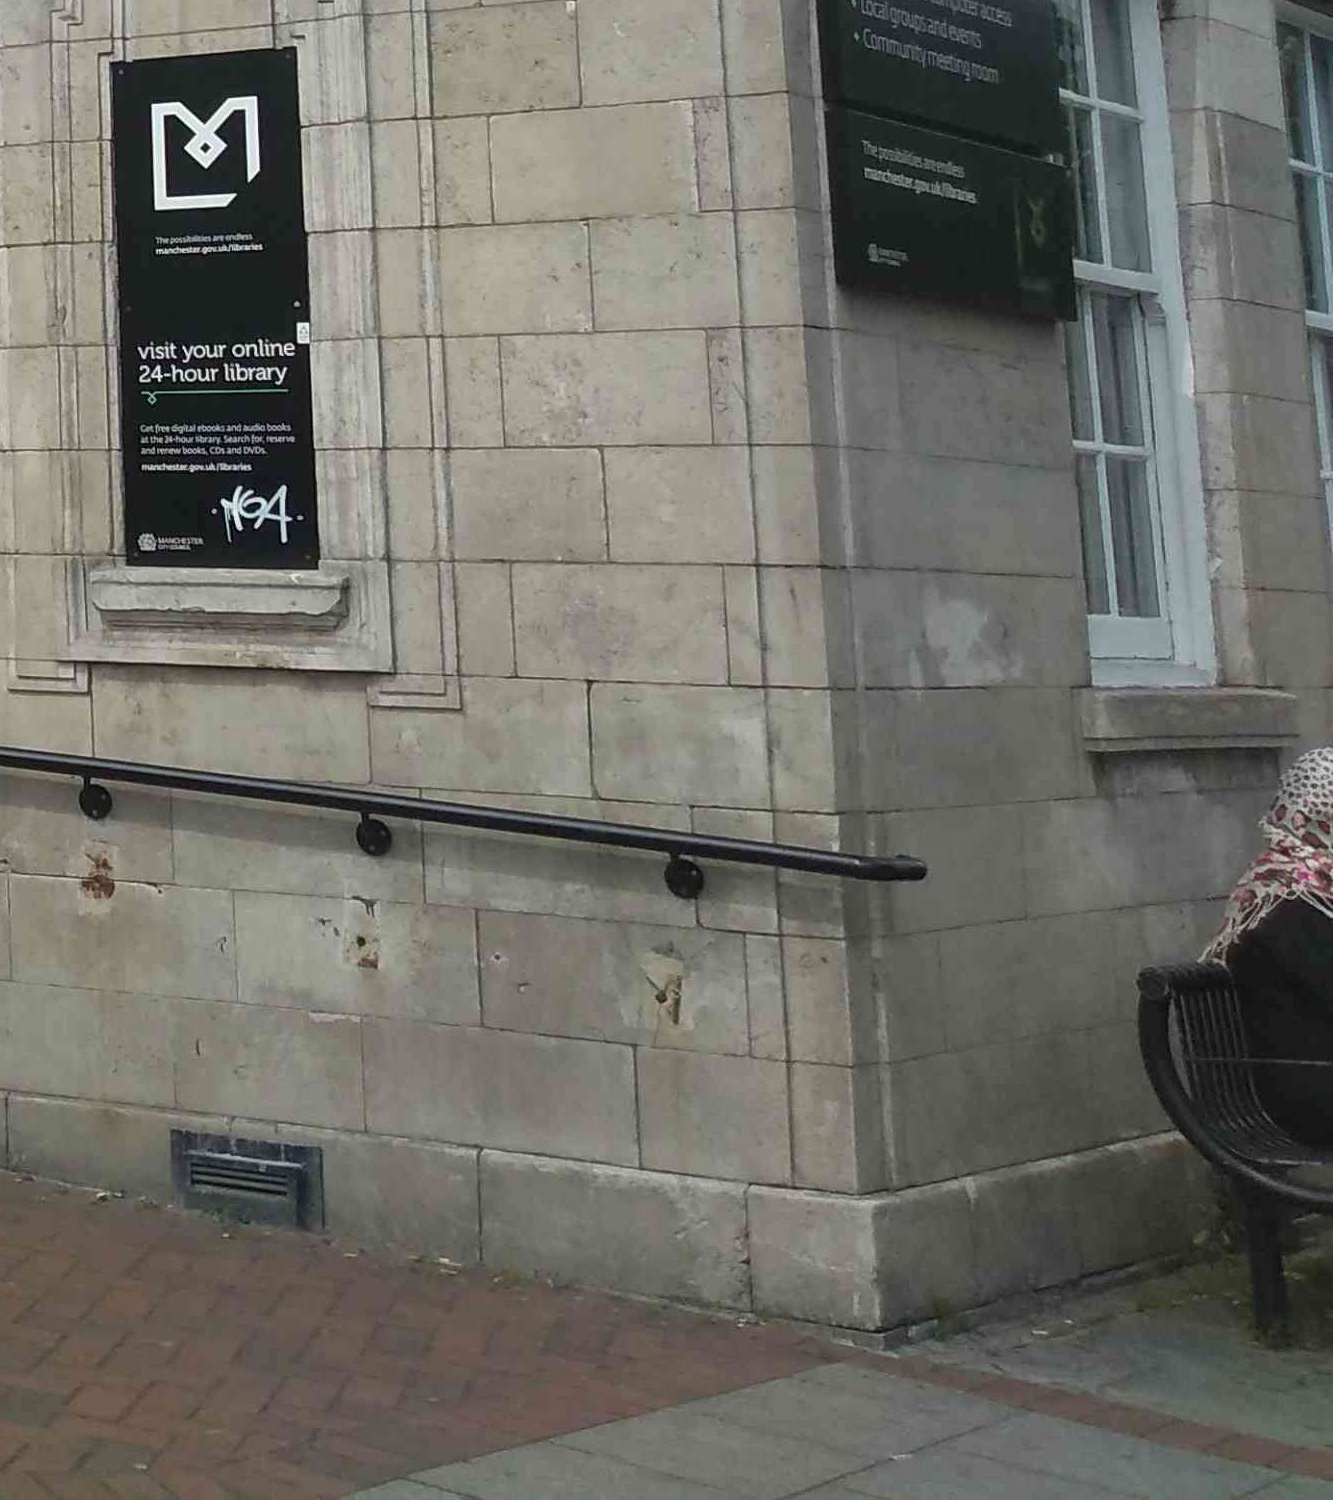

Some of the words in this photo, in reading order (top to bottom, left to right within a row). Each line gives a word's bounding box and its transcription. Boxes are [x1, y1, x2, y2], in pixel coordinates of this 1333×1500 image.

[980, 3, 1013, 27] access
[890, 6, 927, 34] groups
[928, 19, 948, 38] and
[948, 26, 982, 49] events
[862, 28, 927, 69] Community
[928, 51, 971, 82] meeting
[972, 64, 1000, 84] room
[138, 341, 177, 360] visit
[182, 344, 227, 363] your
[232, 339, 296, 358] online
[139, 364, 219, 383] 24-hour
[223, 363, 287, 385] library
[140, 424, 154, 433] Get
[155, 424, 170, 434] free
[171, 424, 196, 434] digital
[197, 424, 225, 433] ebooks
[226, 423, 242, 432] and
[243, 423, 266, 432] audio
[266, 423, 292, 432] books
[140, 436, 149, 444] at
[150, 435, 164, 444] the
[164, 435, 195, 444] 24-hour
[195, 435, 222, 445] library.
[224, 434, 251, 443] Search
[266, 435, 295, 443] reserve
[140, 447, 155, 455] and
[182, 446, 209, 456] books,
[209, 446, 225, 455] CDs
[226, 446, 242, 455] and
[243, 446, 268, 455] DVDs.
[141, 461, 252, 473] manchester.gov.uk/libraries
